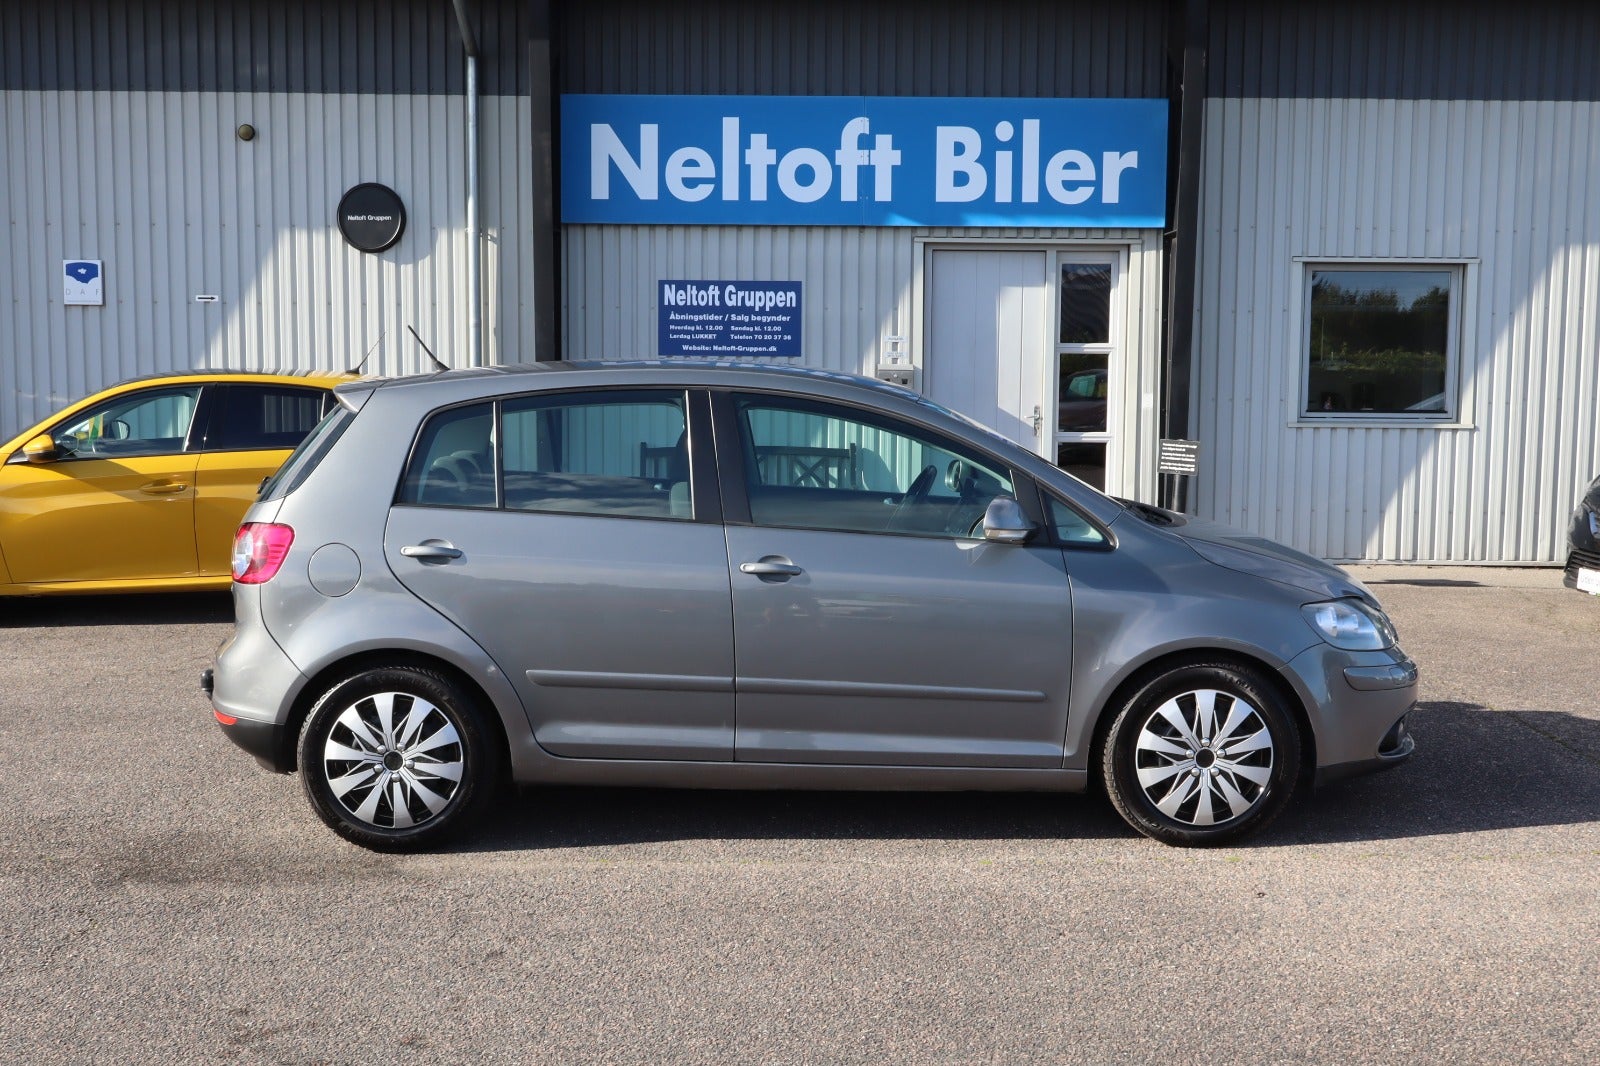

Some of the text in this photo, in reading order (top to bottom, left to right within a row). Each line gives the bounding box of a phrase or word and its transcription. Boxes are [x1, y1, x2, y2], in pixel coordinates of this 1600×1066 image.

[591, 117, 1138, 205] Neltoft Biler
[664, 284, 797, 312] Neltoft Gruppen
[669, 311, 792, 323] Åbningstider / Salg begynder
[712, 344, 777, 353] Neltoft-Gruppen.dk
